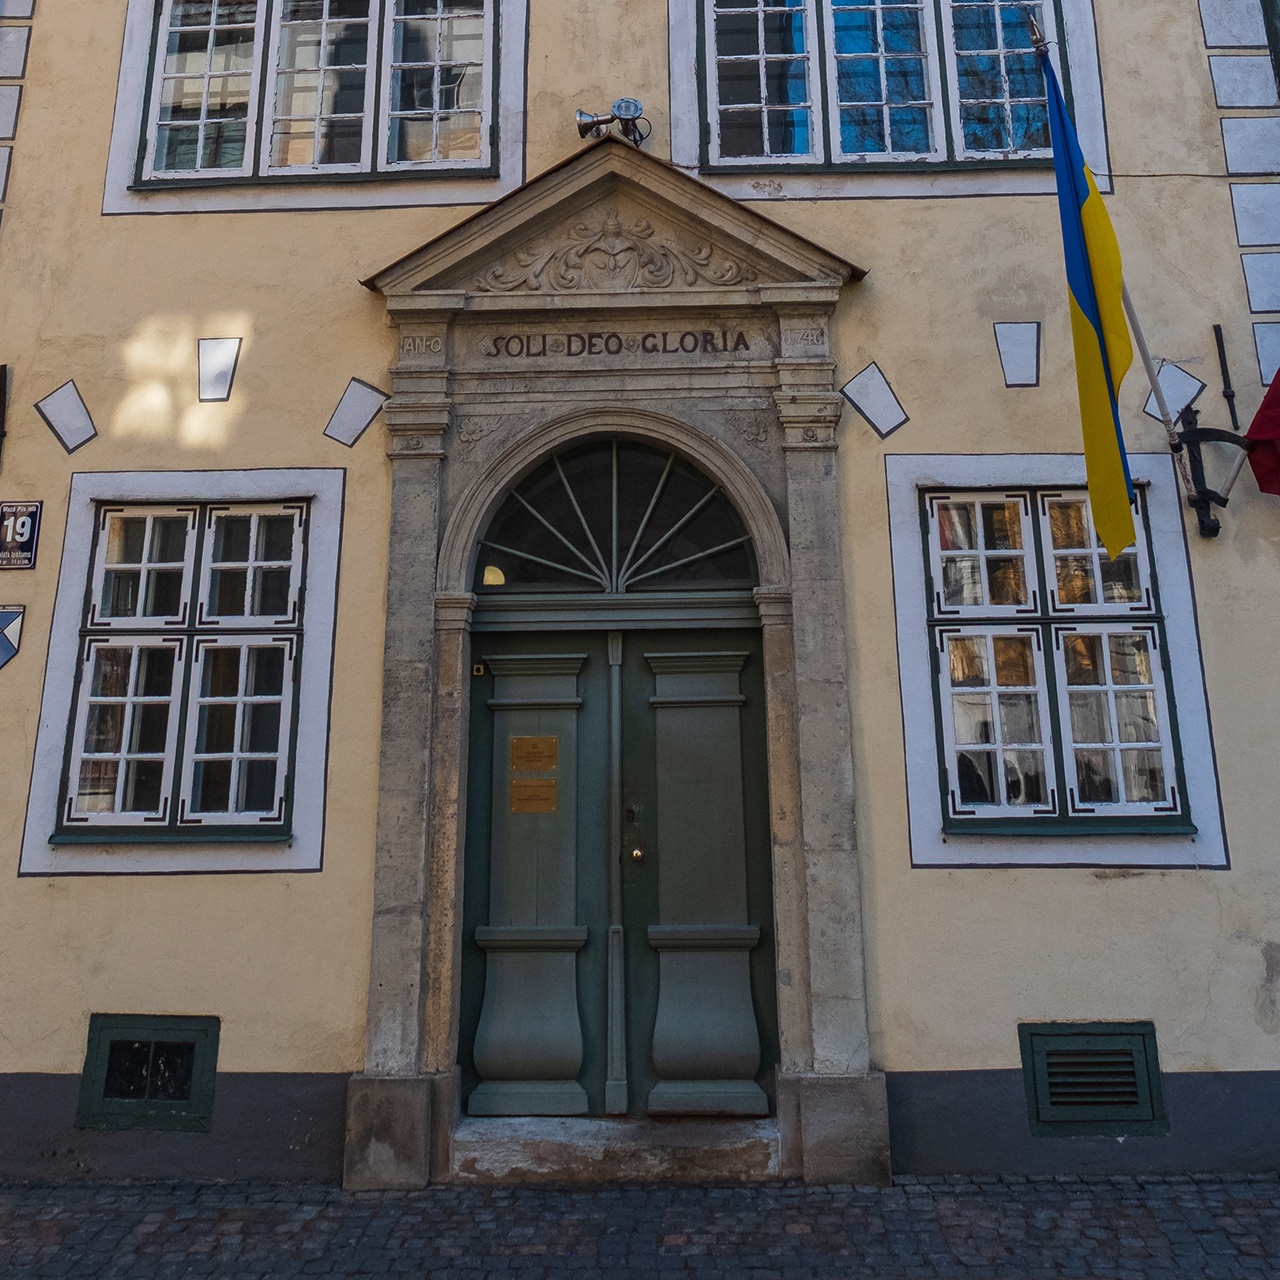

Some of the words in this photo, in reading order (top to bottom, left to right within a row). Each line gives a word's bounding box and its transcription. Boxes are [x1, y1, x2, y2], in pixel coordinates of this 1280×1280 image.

[486, 335, 548, 358] SOLI
[566, 332, 621, 357] DEO
[641, 331, 750, 355] GLORIA
[4, 516, 32, 542] 19
